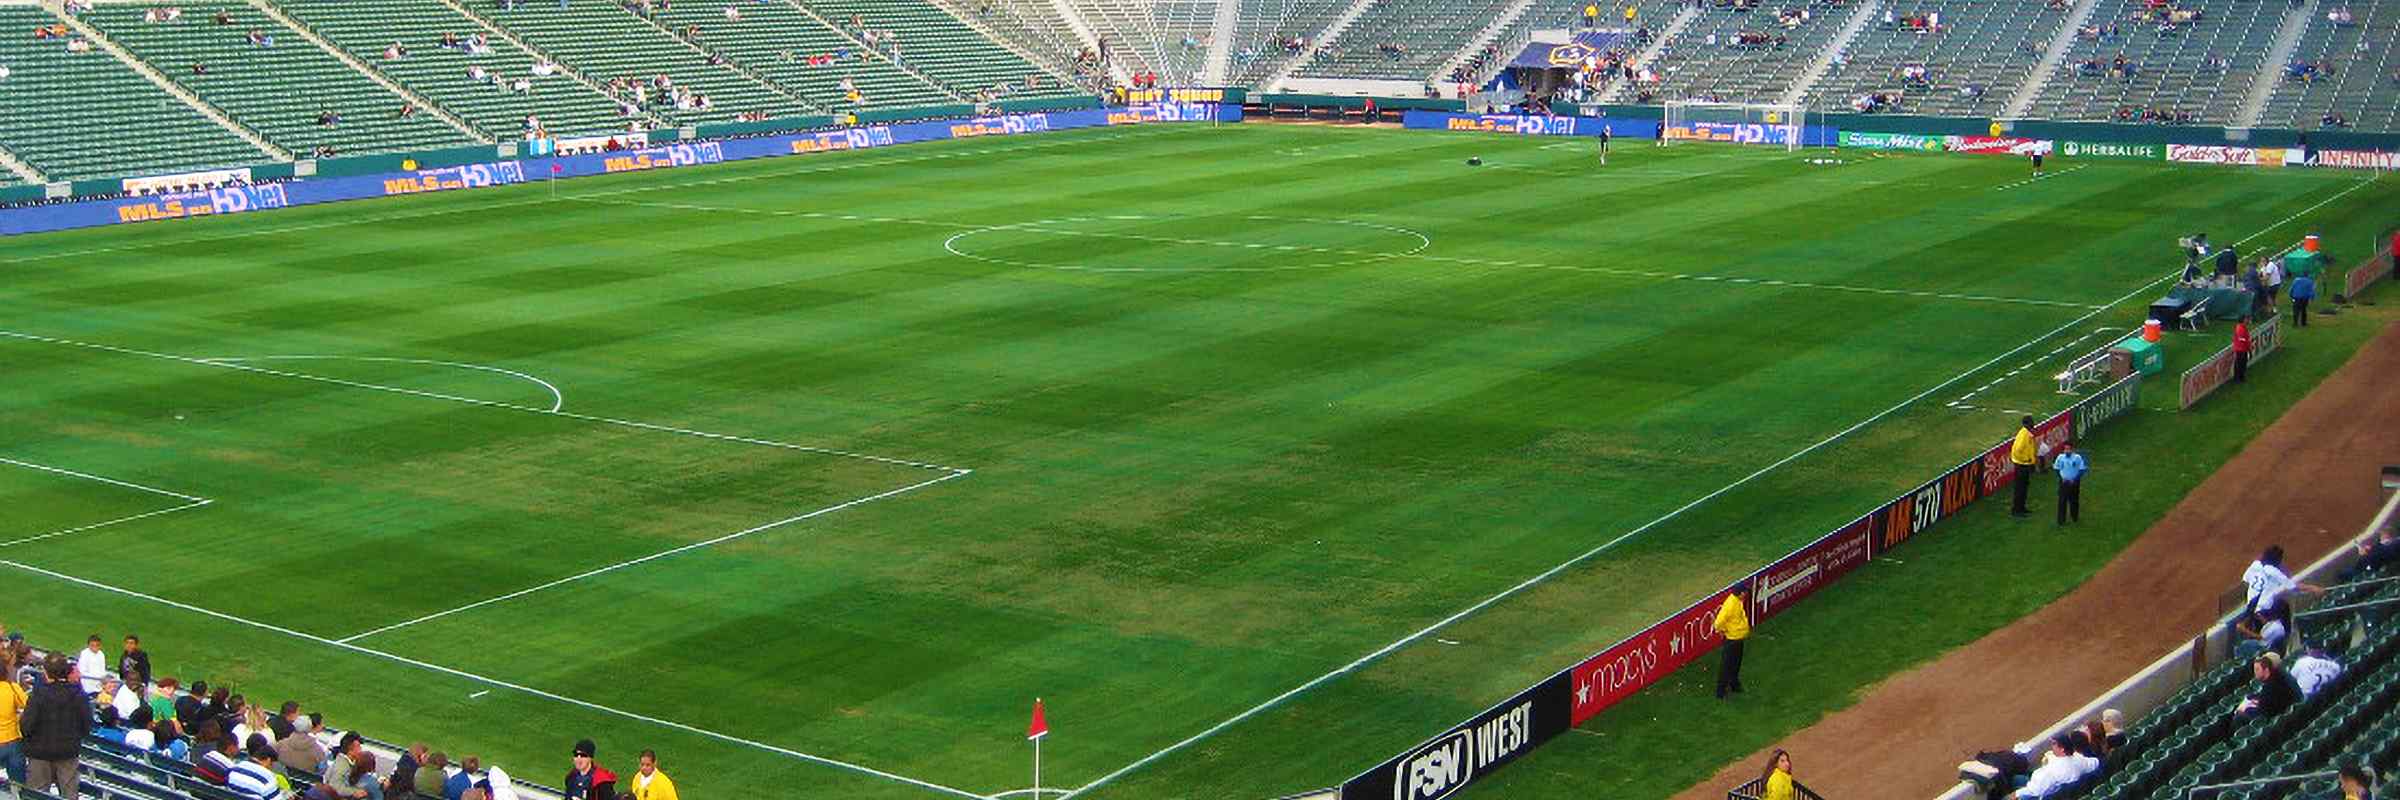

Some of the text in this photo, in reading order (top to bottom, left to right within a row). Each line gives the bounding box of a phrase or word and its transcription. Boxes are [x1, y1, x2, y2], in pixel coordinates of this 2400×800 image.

[2081, 143, 2156, 158] HERBALIFE
[384, 175, 438, 194] MLS
[119, 201, 184, 222] MLS
[1913, 482, 1940, 533] 570
[1589, 639, 1657, 704] macy's
[1407, 700, 1532, 800] FSN WEST
